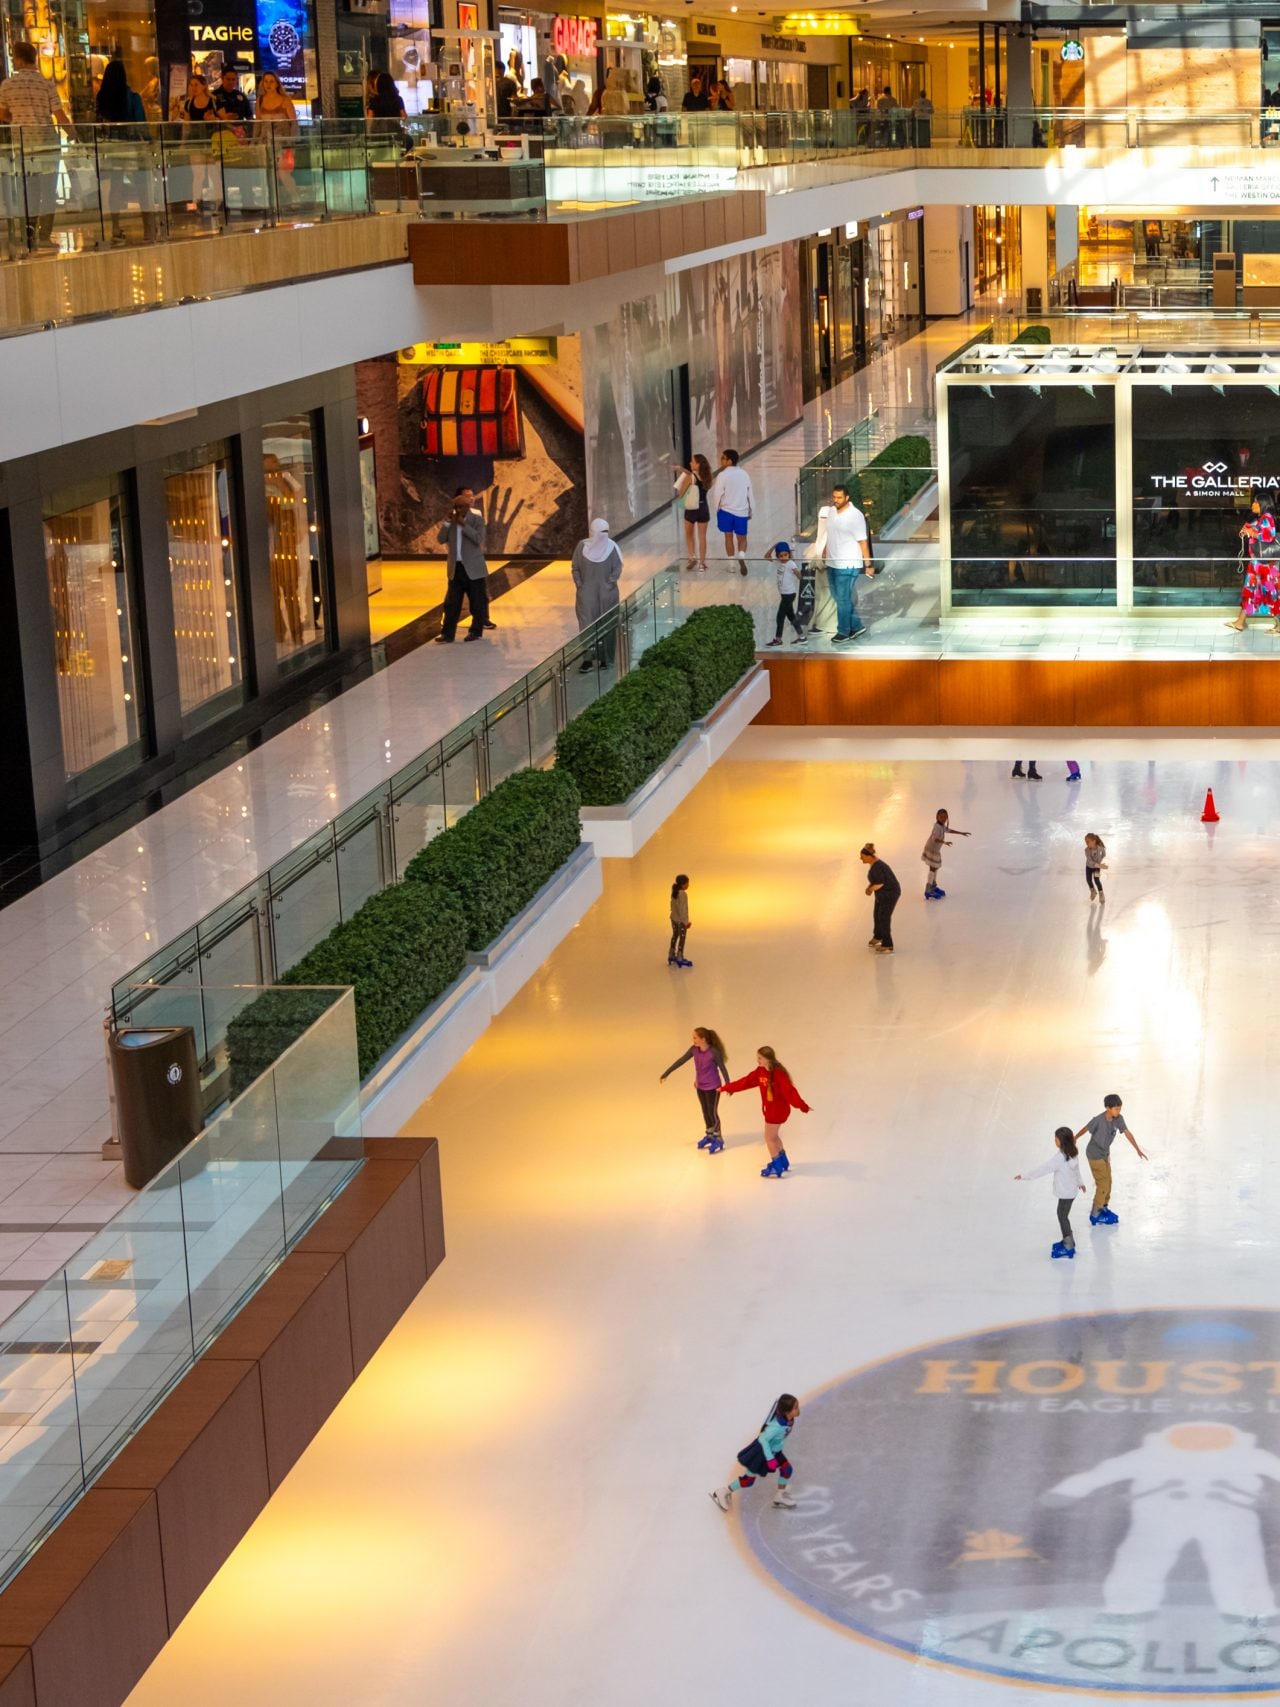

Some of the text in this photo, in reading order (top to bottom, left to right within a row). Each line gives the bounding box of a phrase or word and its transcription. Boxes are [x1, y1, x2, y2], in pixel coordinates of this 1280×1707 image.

[554, 16, 598, 57] GARAGE
[278, 76, 308, 84] ROSPEX
[1151, 476, 1280, 488] THE GALLERIA
[970, 1400, 1026, 1413] THE
[1038, 1398, 1175, 1414] EAGLE
[1188, 1400, 1253, 1414] HAS
[783, 1484, 923, 1614] 50 YEARS
